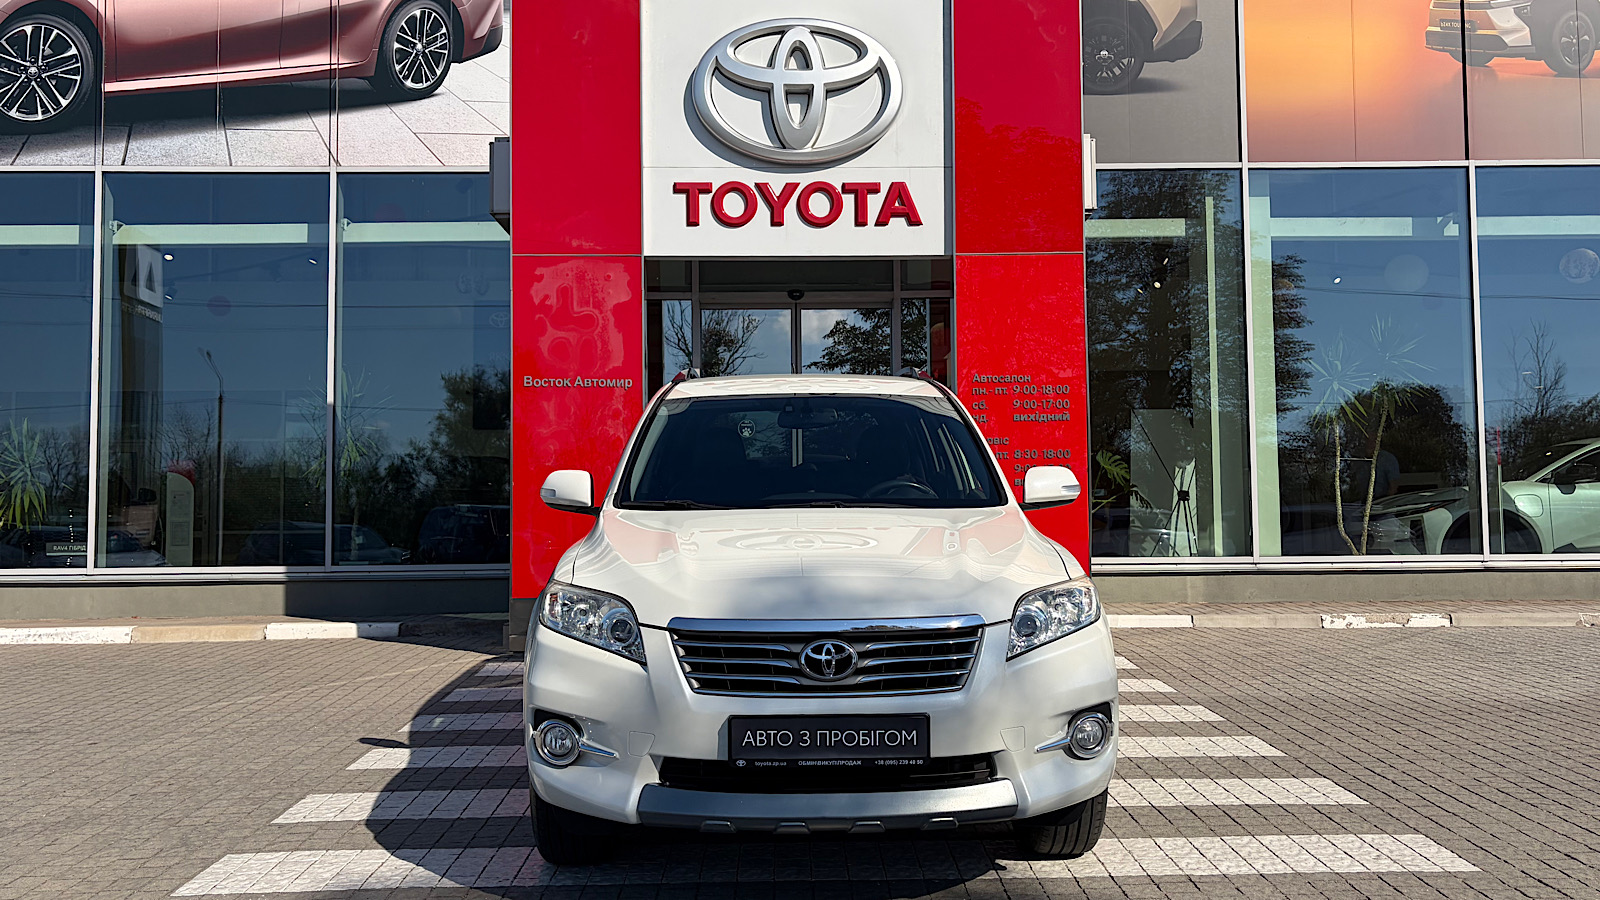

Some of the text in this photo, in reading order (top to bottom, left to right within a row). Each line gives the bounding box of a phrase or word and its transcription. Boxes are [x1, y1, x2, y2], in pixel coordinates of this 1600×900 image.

[673, 180, 923, 228] TOYOTA
[523, 375, 633, 390] Восток Автомир
[972, 373, 1031, 383] Автосалон
[1013, 384, 1070, 395] 9:00-18:00
[972, 399, 1070, 410] сб. 9:00-17:00
[1013, 411, 1070, 423] вихідний
[987, 437, 1010, 445] рвіс
[1013, 449, 1071, 459] 8:30-18:00
[742, 730, 793, 747] АВТО
[817, 730, 917, 747] ПРОБІГОМ
